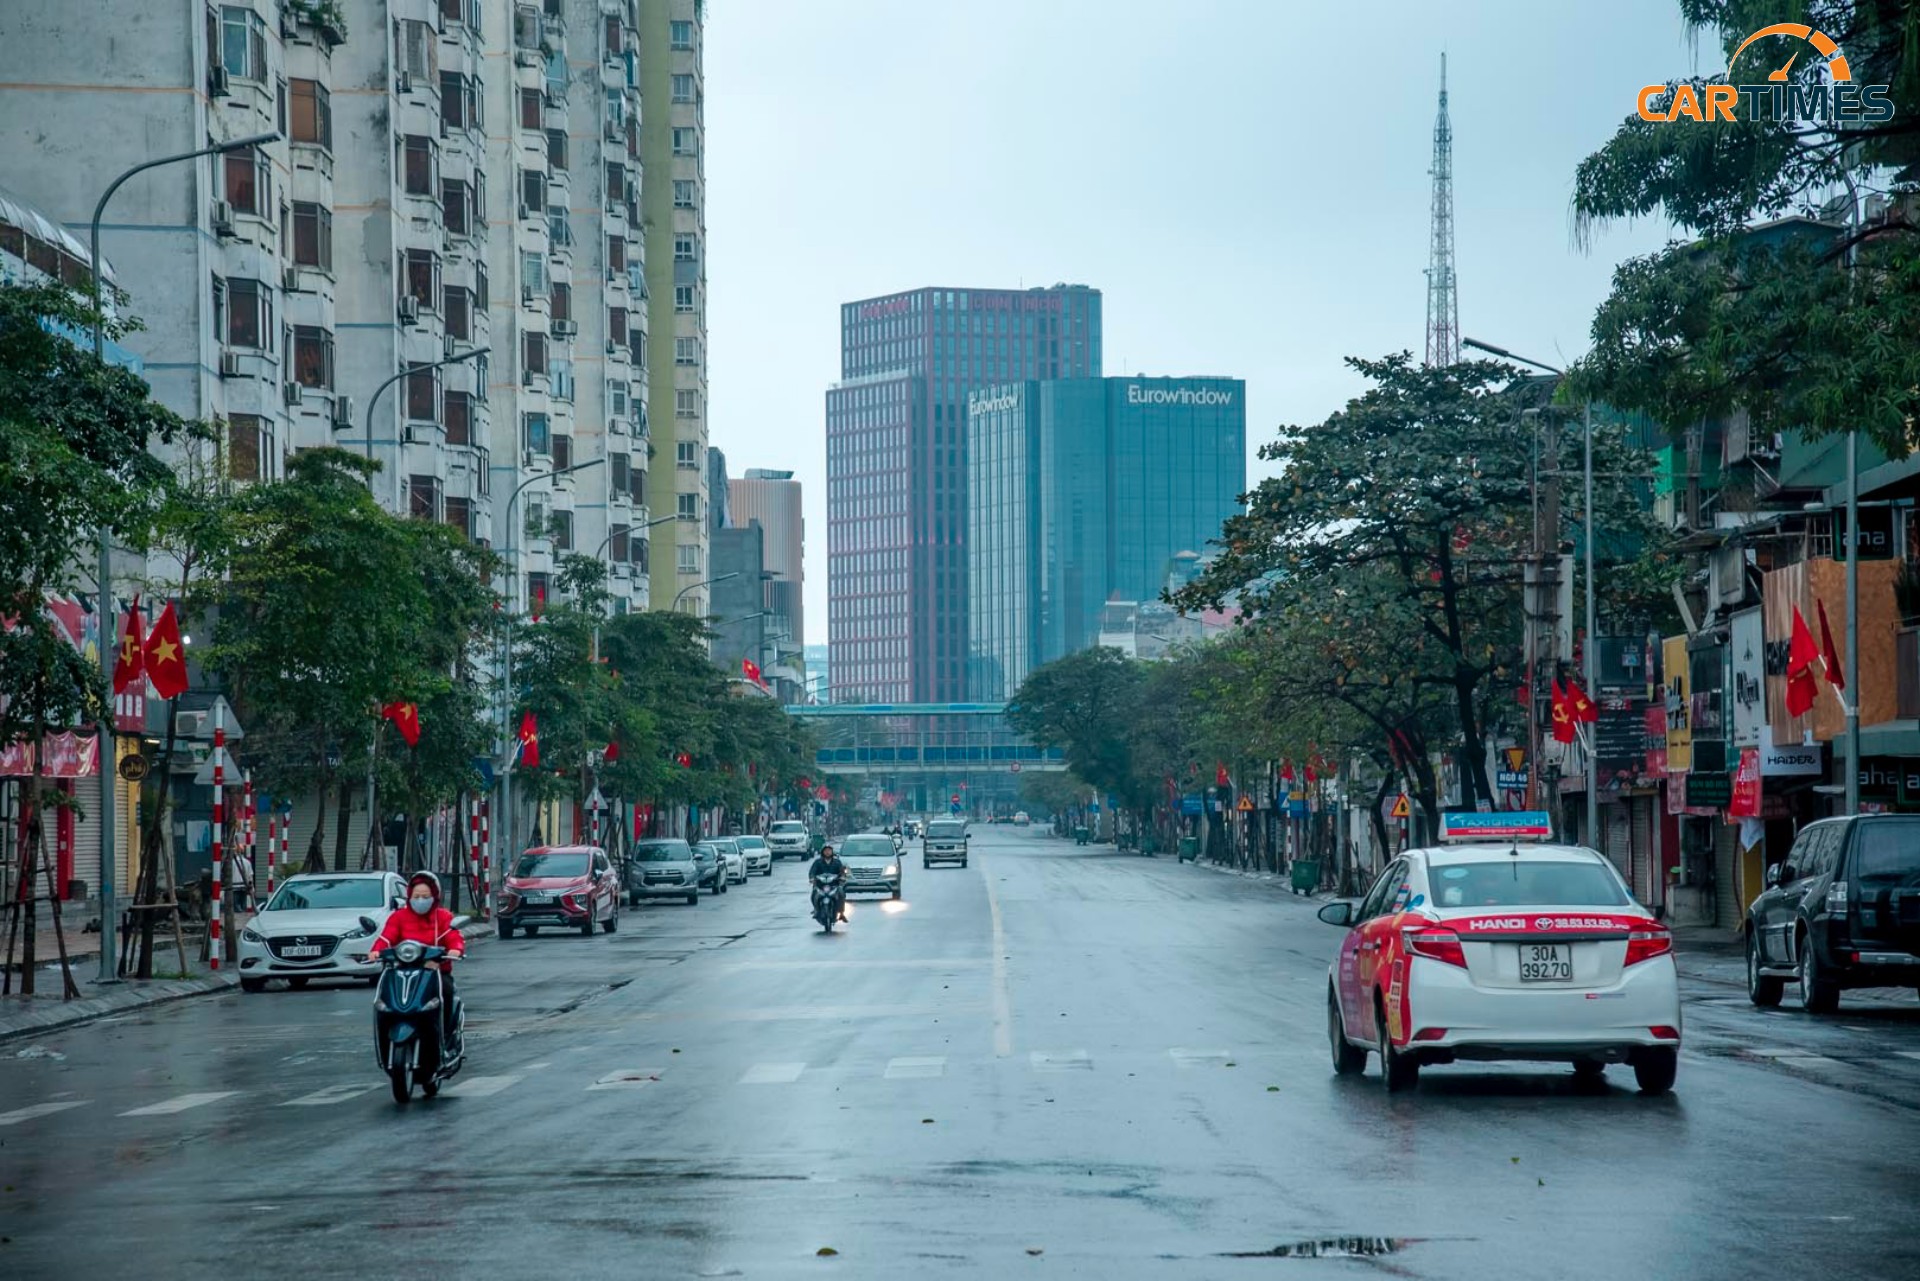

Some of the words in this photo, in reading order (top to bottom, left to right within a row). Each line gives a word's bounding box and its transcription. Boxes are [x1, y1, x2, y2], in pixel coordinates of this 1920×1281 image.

[967, 393, 1018, 416] Eurowindow
[1128, 384, 1232, 405] Eurowindow
[1531, 946, 1558, 961] 30A
